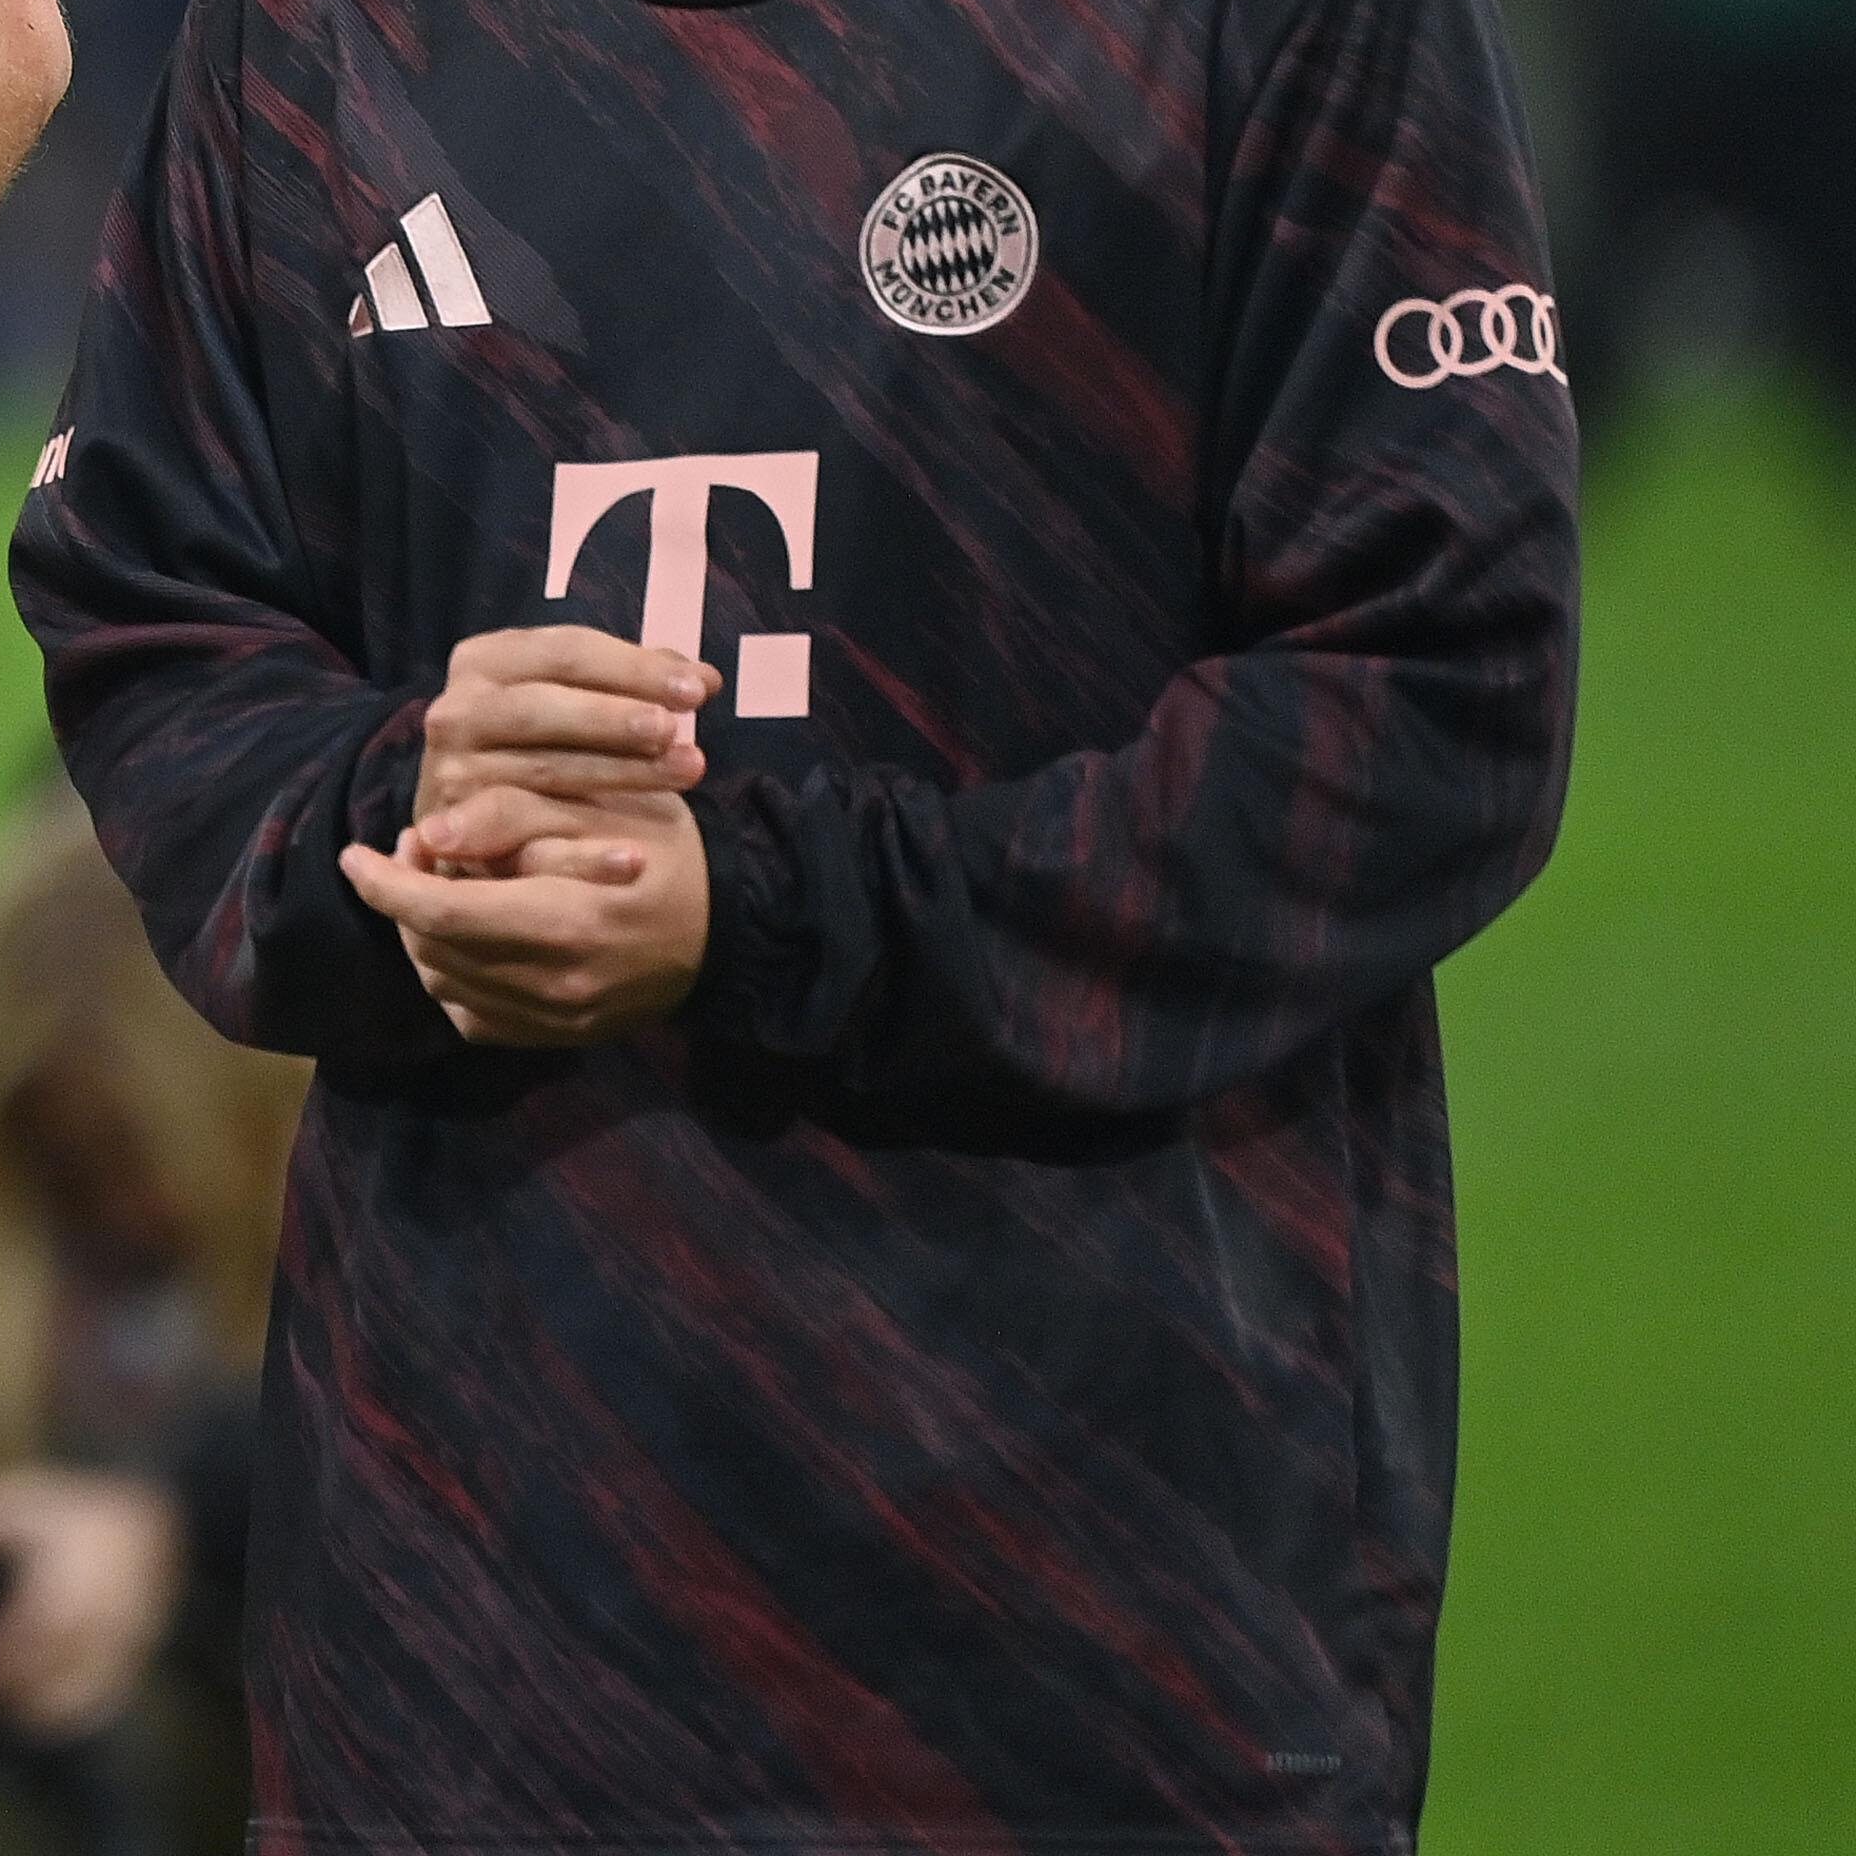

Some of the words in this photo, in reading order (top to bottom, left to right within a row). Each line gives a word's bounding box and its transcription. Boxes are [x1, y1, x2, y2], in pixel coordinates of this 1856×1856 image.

[882, 191, 915, 232] FC
[918, 170, 1021, 237] BAYERN
[875, 259, 1017, 322] MÜNCHEN
